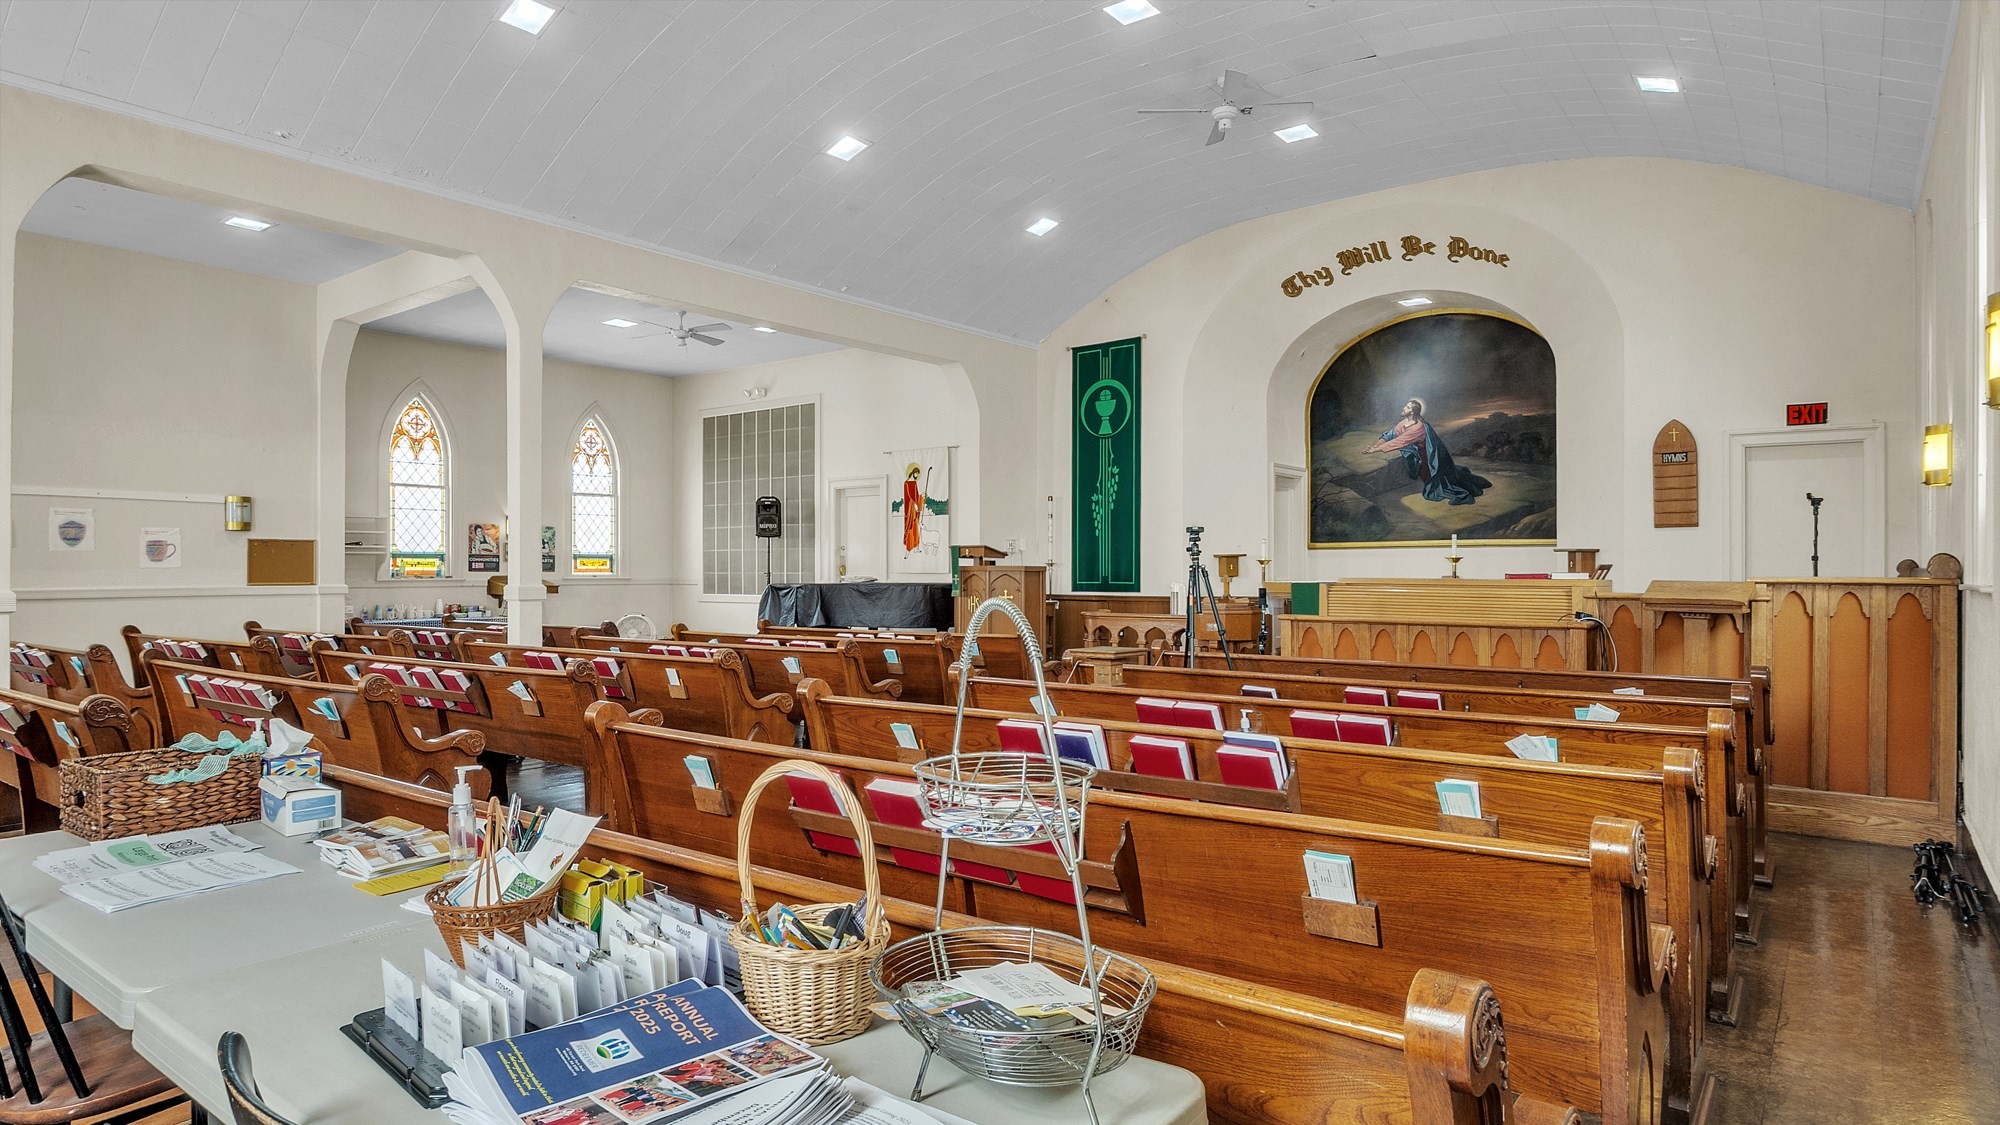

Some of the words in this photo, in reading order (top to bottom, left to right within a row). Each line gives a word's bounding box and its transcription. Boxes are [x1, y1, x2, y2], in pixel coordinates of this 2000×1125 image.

[1281, 266, 1334, 297] Thy
[1336, 240, 1392, 275] Will
[1400, 235, 1436, 261] Be
[1447, 235, 1510, 268] Done
[1788, 404, 1826, 424] EXIT
[1662, 453, 1687, 463] HYMNS
[676, 924, 691, 939] Doug
[495, 978, 514, 998] Florence
[629, 1008, 662, 1035] 2025
[652, 1002, 701, 1045] REPORT
[670, 996, 719, 1041] ANNUAL
